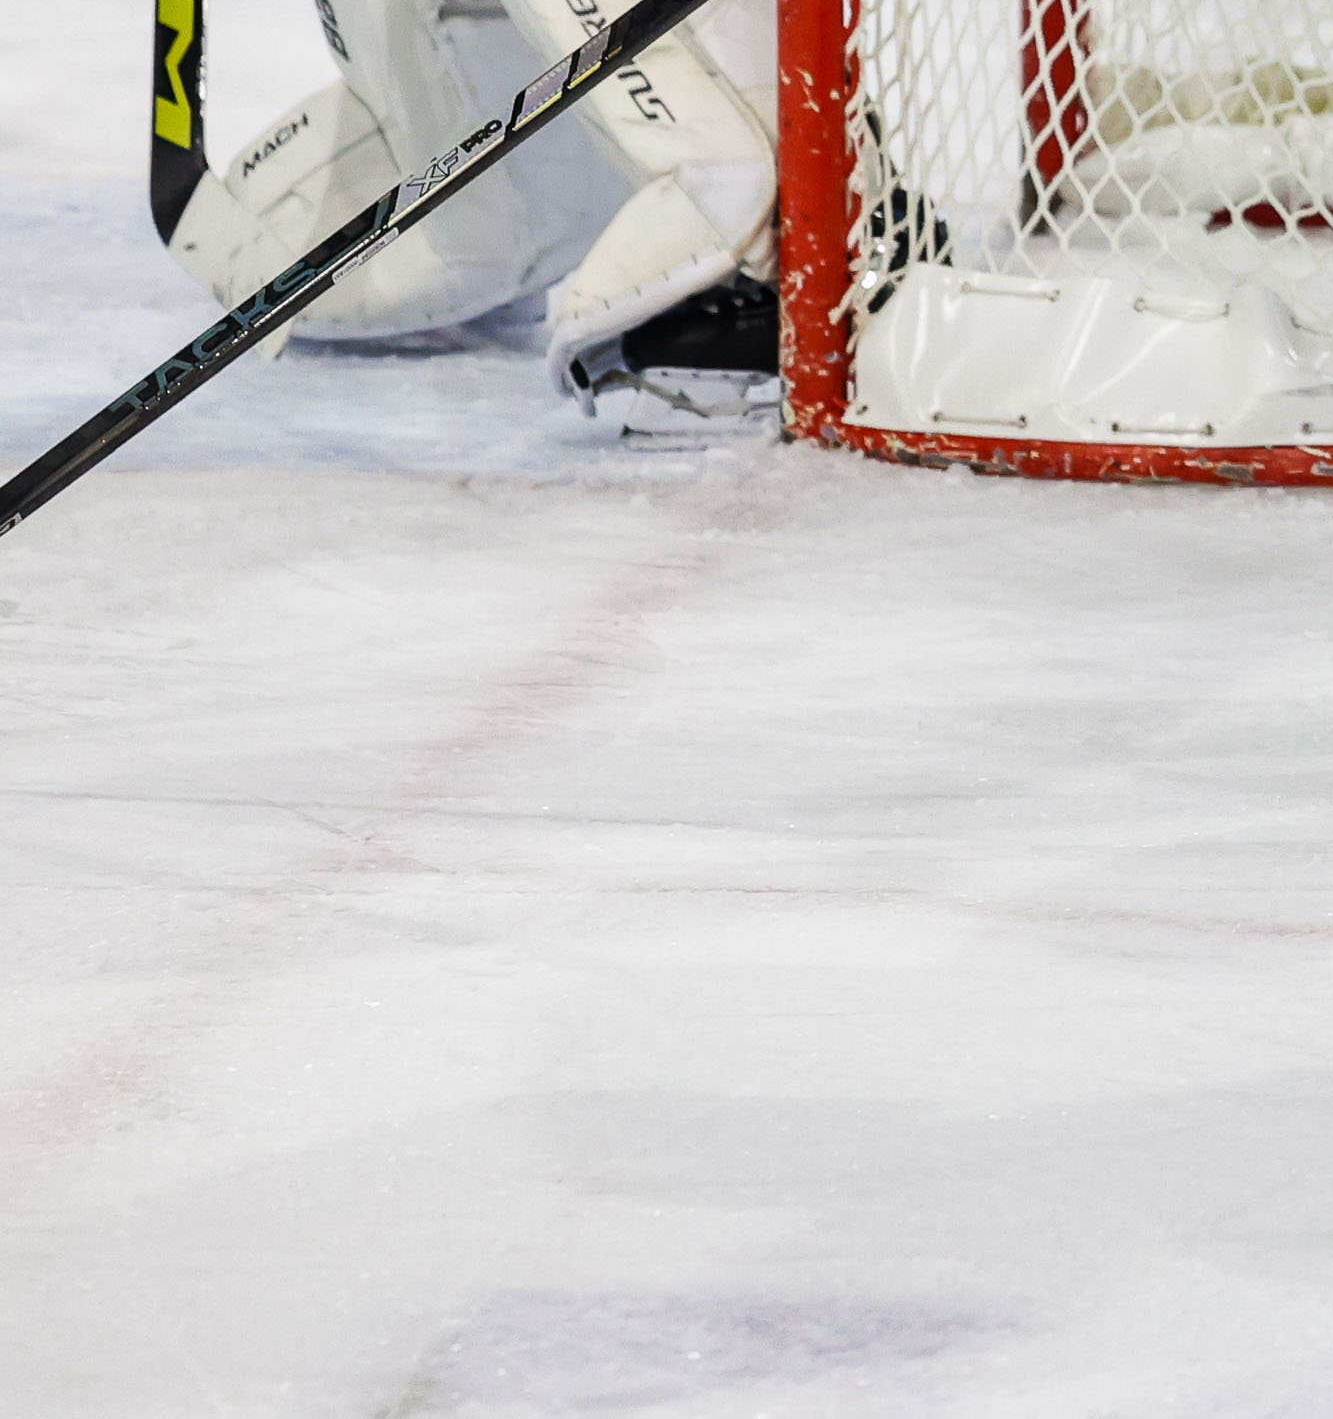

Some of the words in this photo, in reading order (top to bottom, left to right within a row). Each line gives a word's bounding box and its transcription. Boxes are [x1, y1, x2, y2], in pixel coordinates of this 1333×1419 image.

[241, 112, 309, 178] MACH
[460, 119, 503, 154] PRO
[110, 261, 317, 412] TACKS
